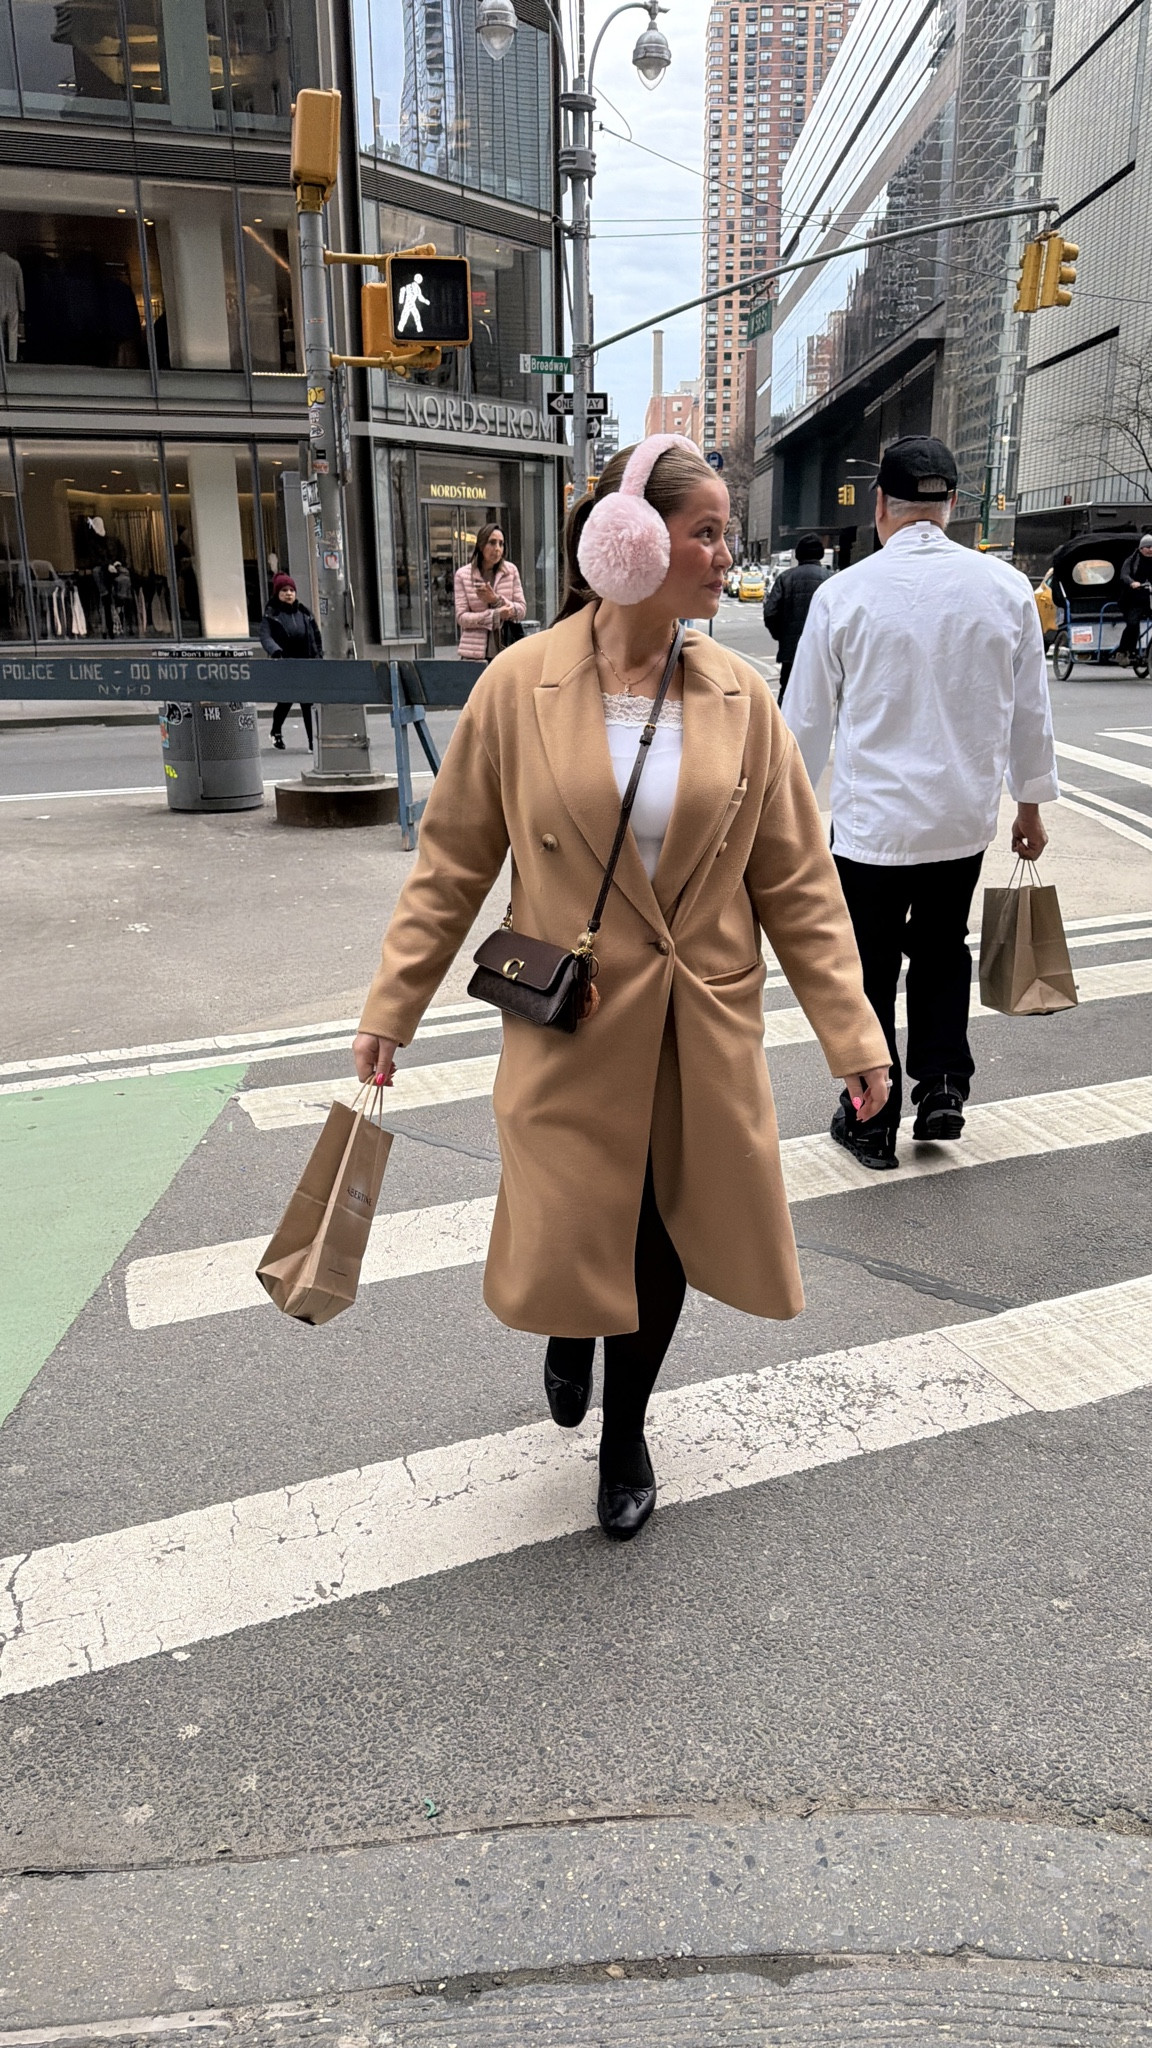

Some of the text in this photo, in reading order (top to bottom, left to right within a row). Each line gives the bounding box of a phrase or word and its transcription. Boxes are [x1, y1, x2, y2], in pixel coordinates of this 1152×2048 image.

[531, 357, 569, 374] Broadway
[556, 400, 600, 409] ONE AY
[404, 392, 554, 441] NORDSTROM
[430, 484, 487, 499] NORDSTROM
[2, 664, 55, 681] POLICE
[69, 664, 103, 681] LINE
[130, 663, 150, 681] DO
[158, 663, 188, 680] NOT
[196, 663, 251, 681] CROSS
